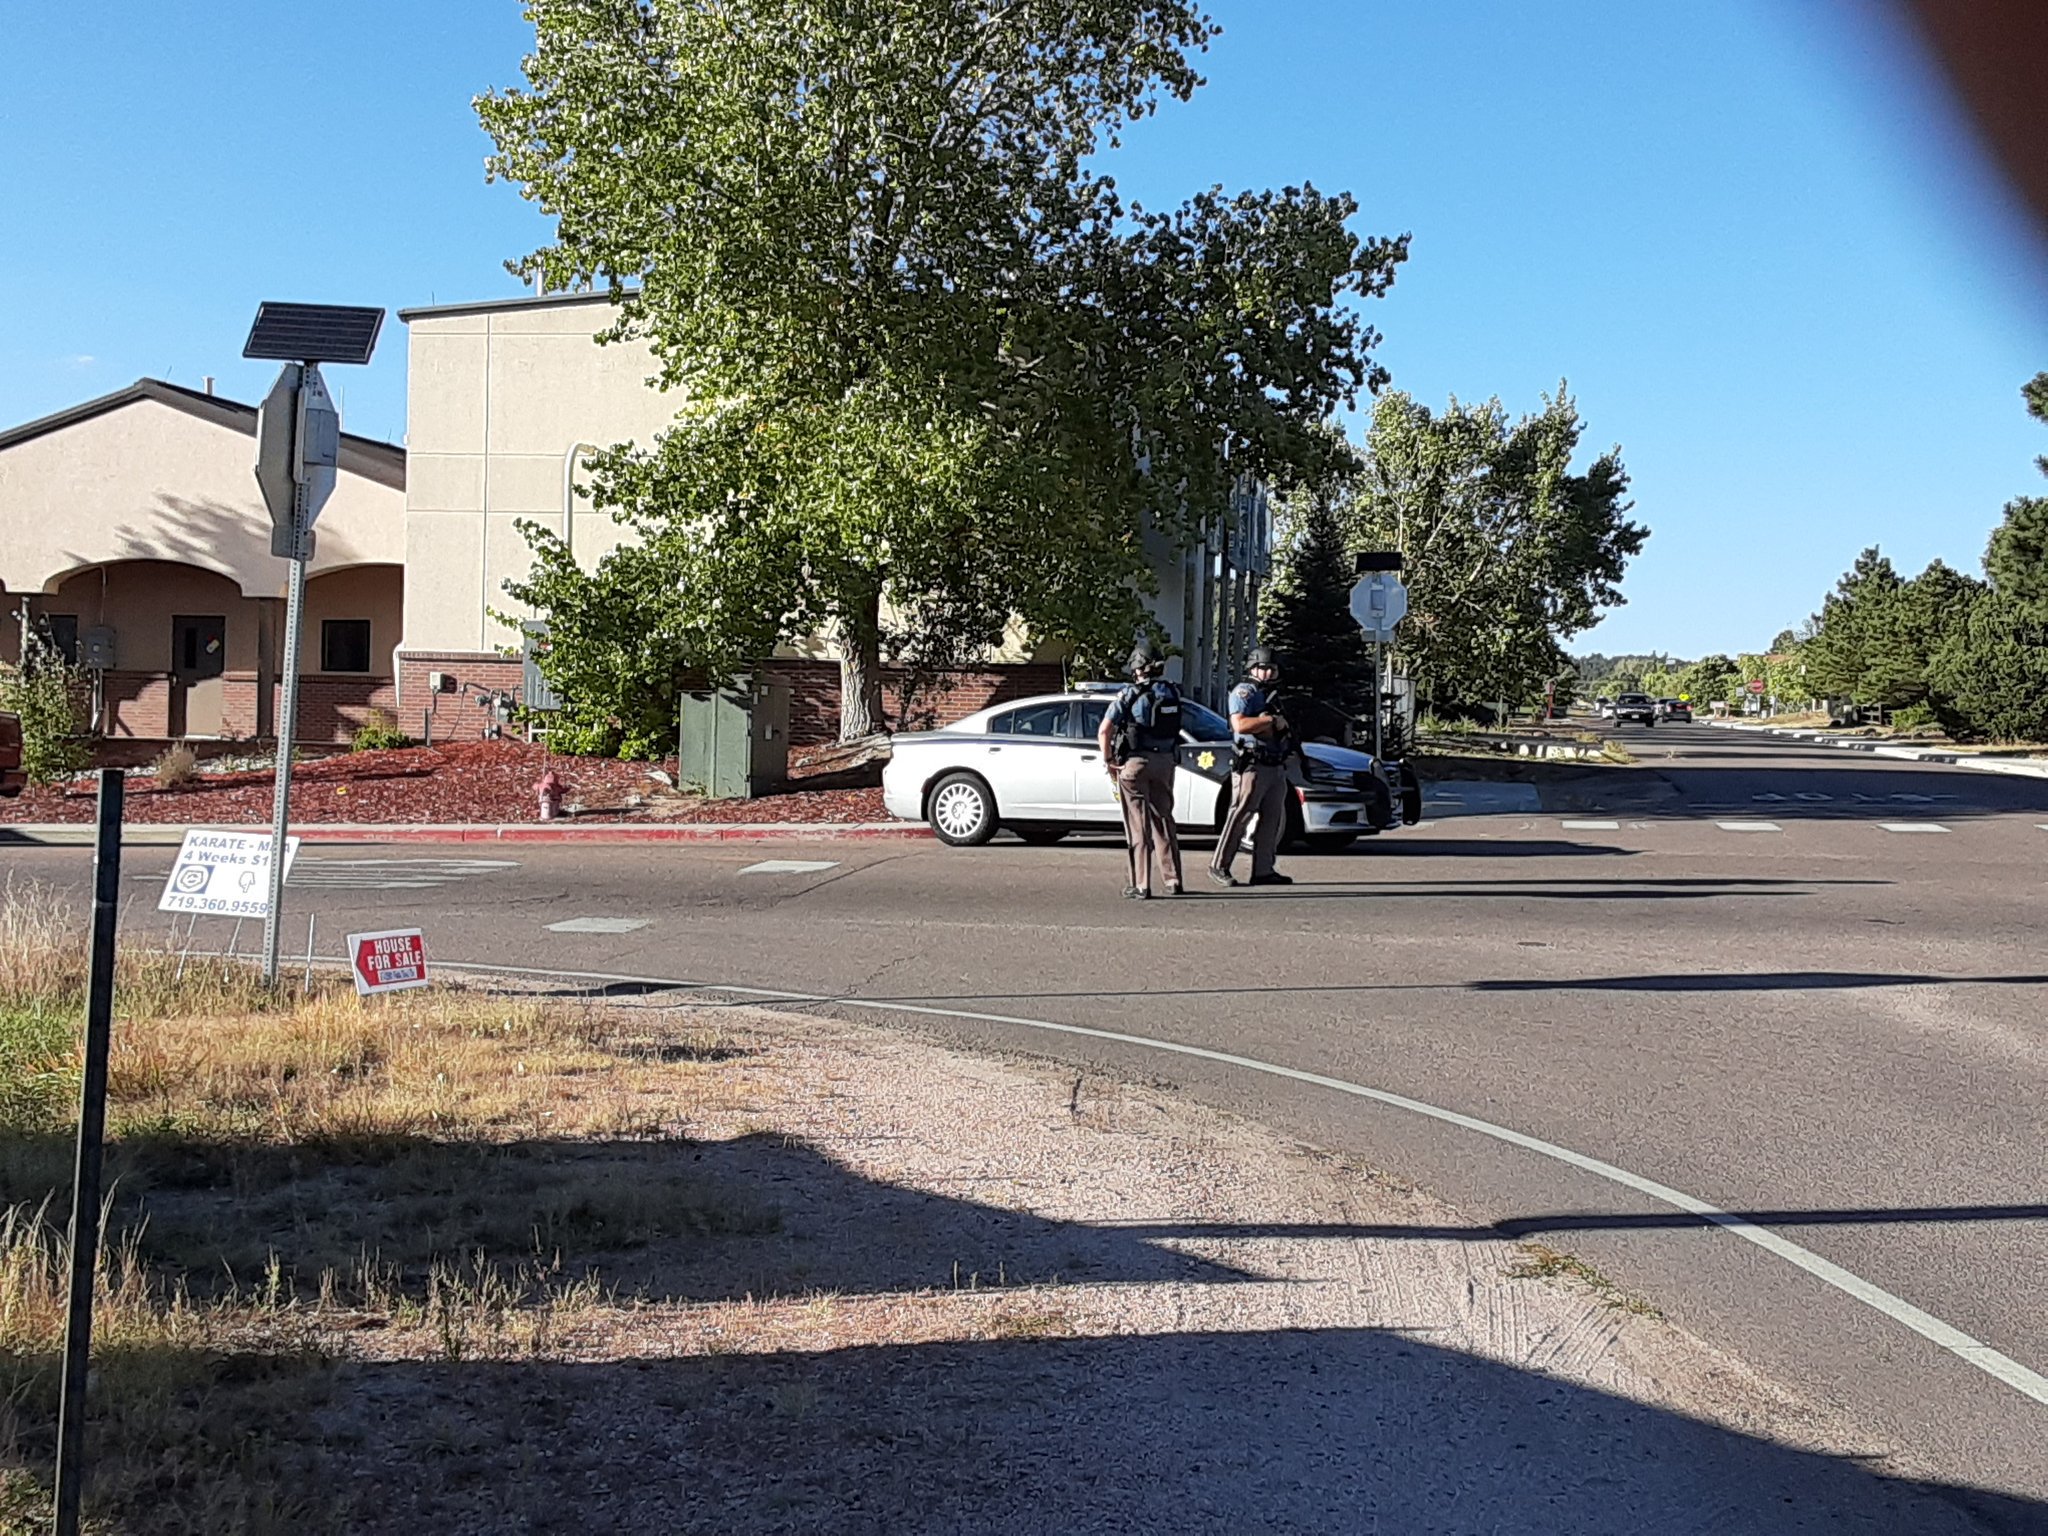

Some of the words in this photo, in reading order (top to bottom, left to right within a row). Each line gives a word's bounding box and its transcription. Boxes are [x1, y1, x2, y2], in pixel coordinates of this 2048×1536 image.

[188, 836, 247, 850] KARATE
[184, 850, 194, 861] 4
[198, 851, 246, 865] Weeks
[167, 896, 268, 914] 719.360.9559
[374, 937, 412, 954] HOUSE
[367, 954, 391, 971] FOR
[395, 950, 422, 967] SALE
